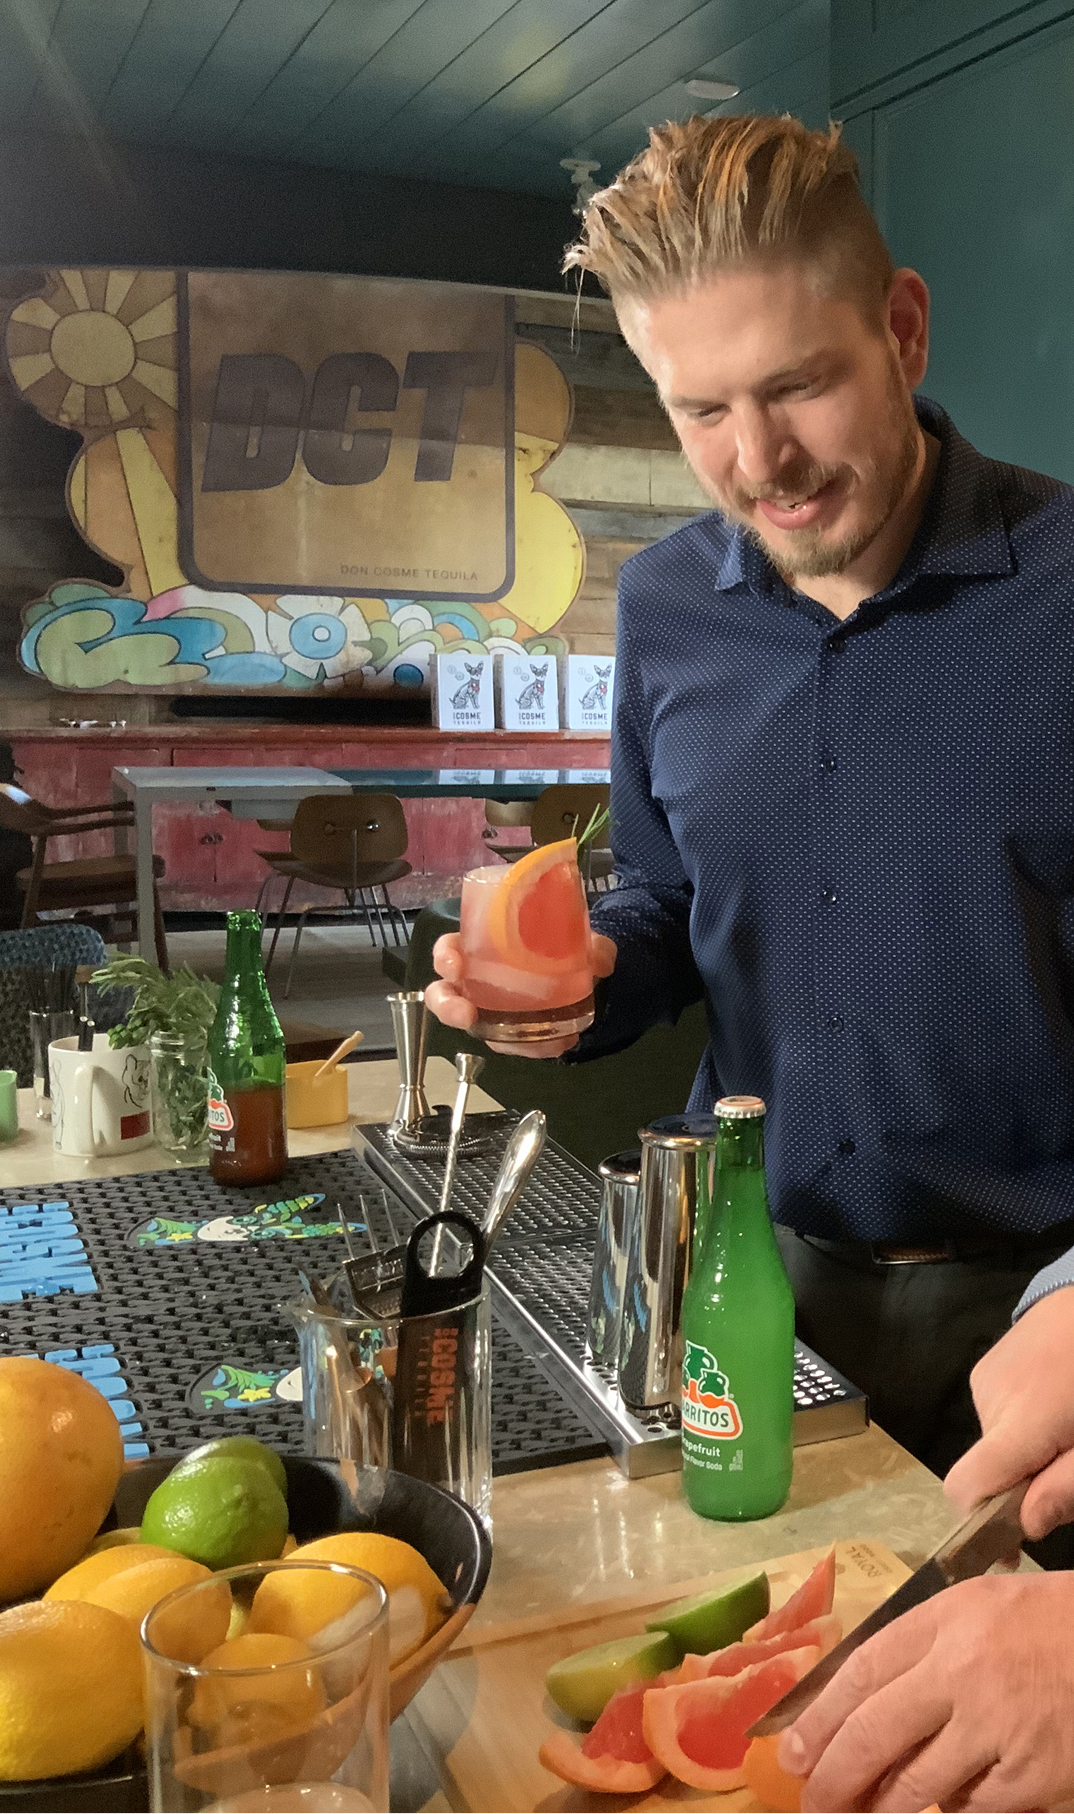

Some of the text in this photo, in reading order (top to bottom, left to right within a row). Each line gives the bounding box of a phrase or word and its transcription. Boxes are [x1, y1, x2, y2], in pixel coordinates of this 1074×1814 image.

[201, 351, 499, 493] DCT
[340, 564, 479, 582] DON COSME TEQUILA
[845, 1546, 883, 1578] ROYAL
